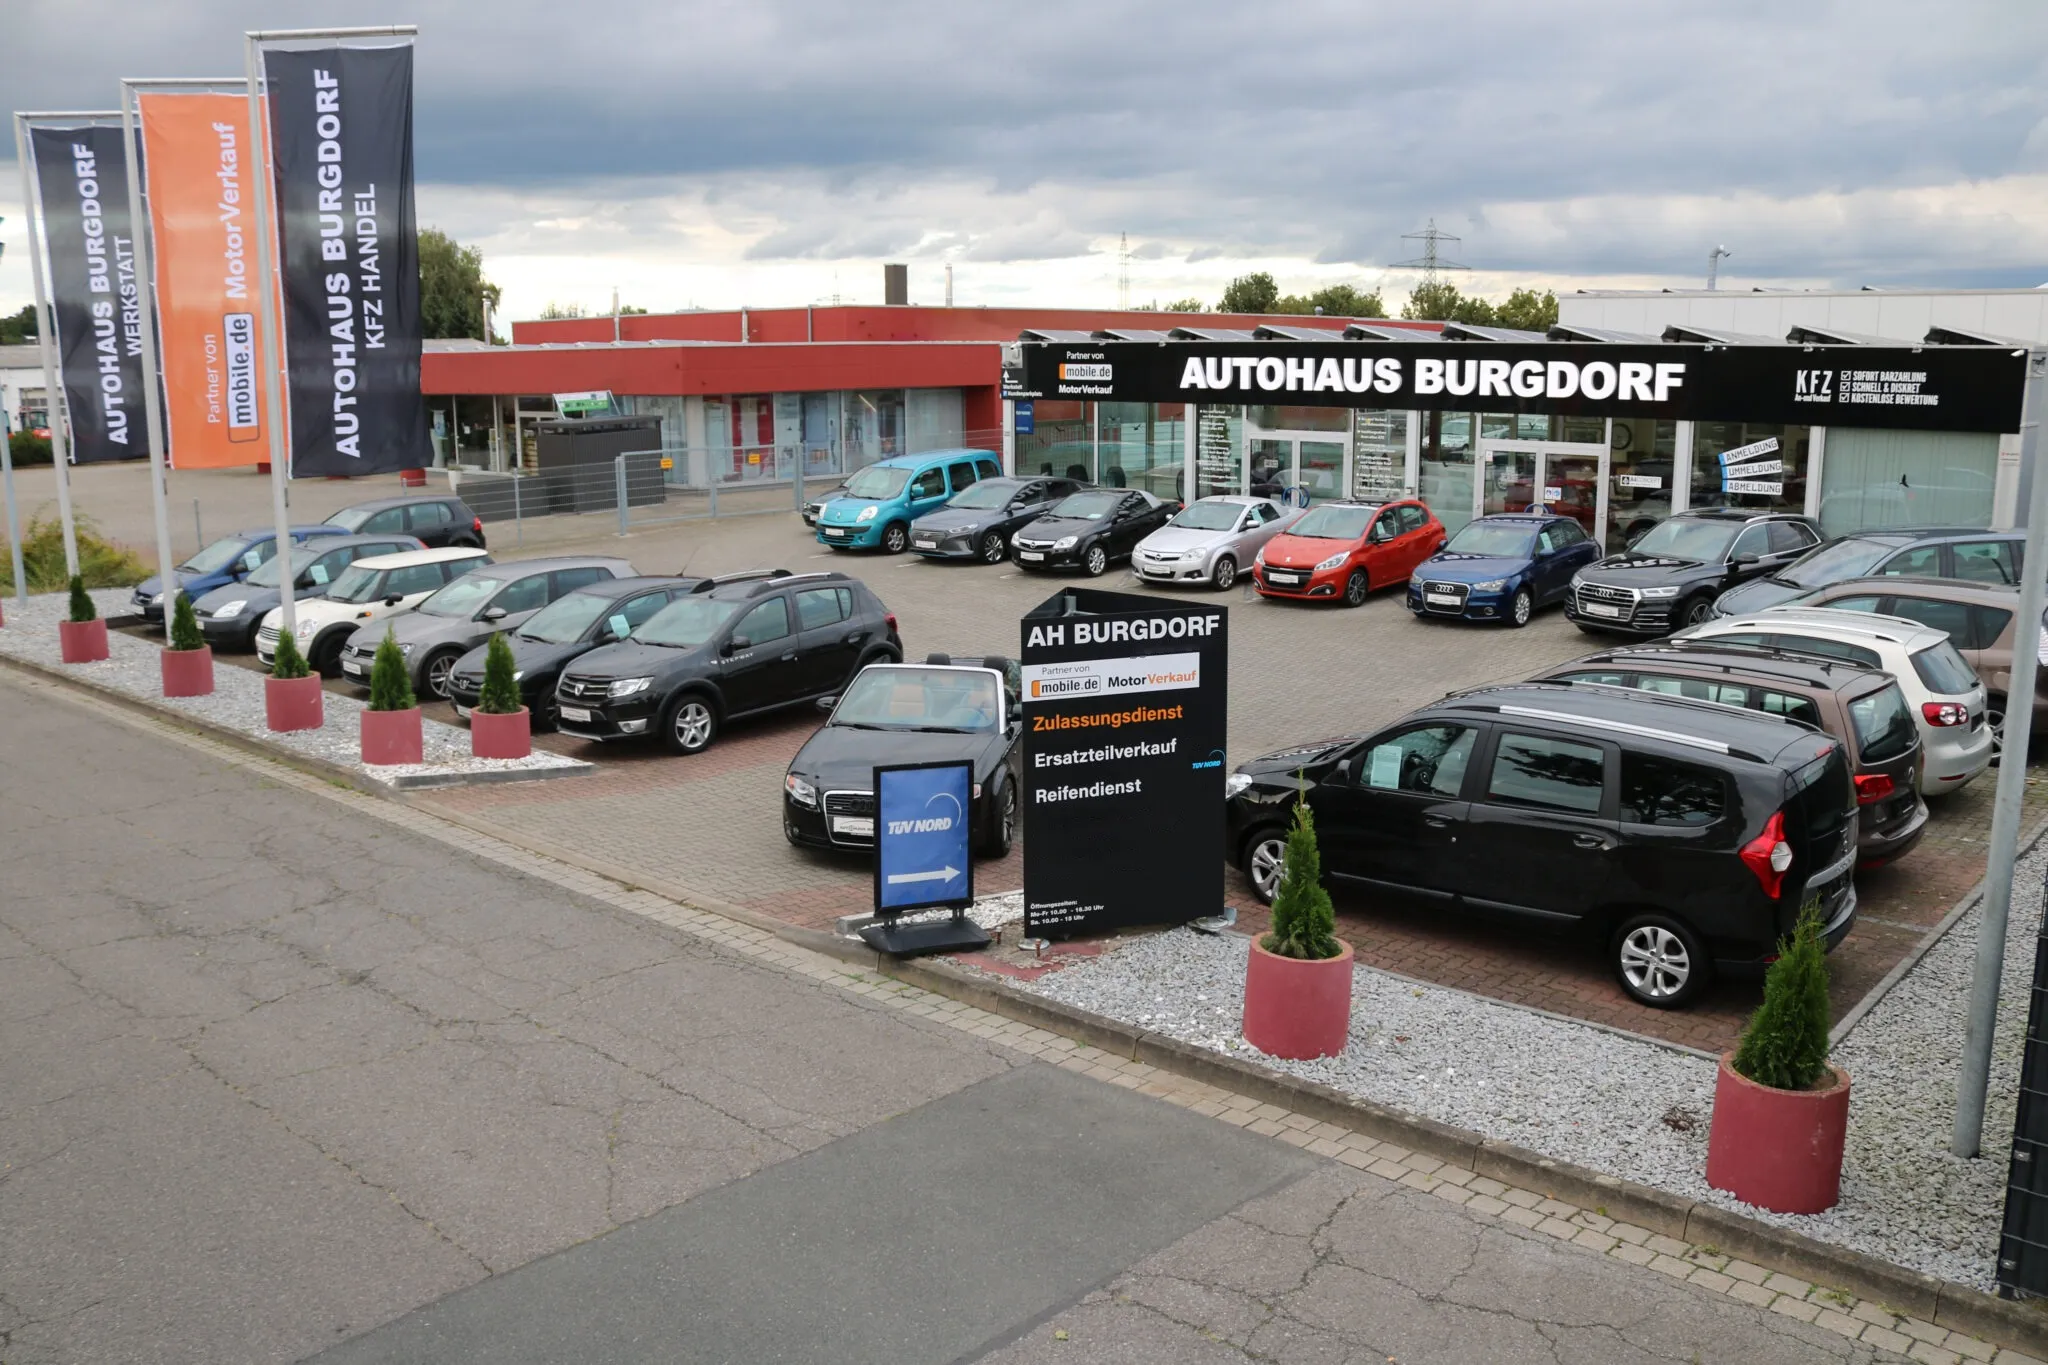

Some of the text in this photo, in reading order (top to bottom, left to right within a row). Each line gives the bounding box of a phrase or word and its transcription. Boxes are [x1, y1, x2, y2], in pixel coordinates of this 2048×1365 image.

[212, 122, 247, 300] MotorVerkauf
[314, 69, 361, 458] AUTOHAUS BURGDORF
[354, 183, 386, 349] KFZ HANDEL
[72, 143, 129, 445] AUTOHAUS BURGDORF
[114, 236, 142, 357] WERKSTATT
[1066, 351, 1104, 360] Partner von
[204, 334, 221, 423] Partner von
[230, 318, 252, 423] mobile.de
[1066, 366, 1110, 377] mobile.de
[1180, 356, 1686, 402] AUTOHAUS BURGDORF
[1796, 370, 1833, 394] KFZ
[1852, 371, 1927, 383] SOFORT BARZAHLUNG
[1059, 384, 1113, 395] MotorVerkauf
[1851, 382, 1921, 394] SCHNELL & DISKRET
[1851, 393, 1939, 406] KOSTENLOSE BEWERTUNG
[1726, 439, 1779, 462] ANMELDUNG
[1728, 463, 1782, 476] UMMELDUNG
[1728, 481, 1781, 493] ABMELDUNG
[1027, 615, 1220, 647] AH BURGDORF
[1042, 664, 1090, 675] Partner von
[1041, 670, 1196, 693] mobile.de MotorVerkauf
[1033, 705, 1183, 732] Zulassungsdienst
[1035, 738, 1177, 767] Ersatzteilverkauf
[1204, 760, 1221, 768] NORD
[1035, 779, 1142, 803] Reifendienst
[914, 817, 952, 832] NORD
